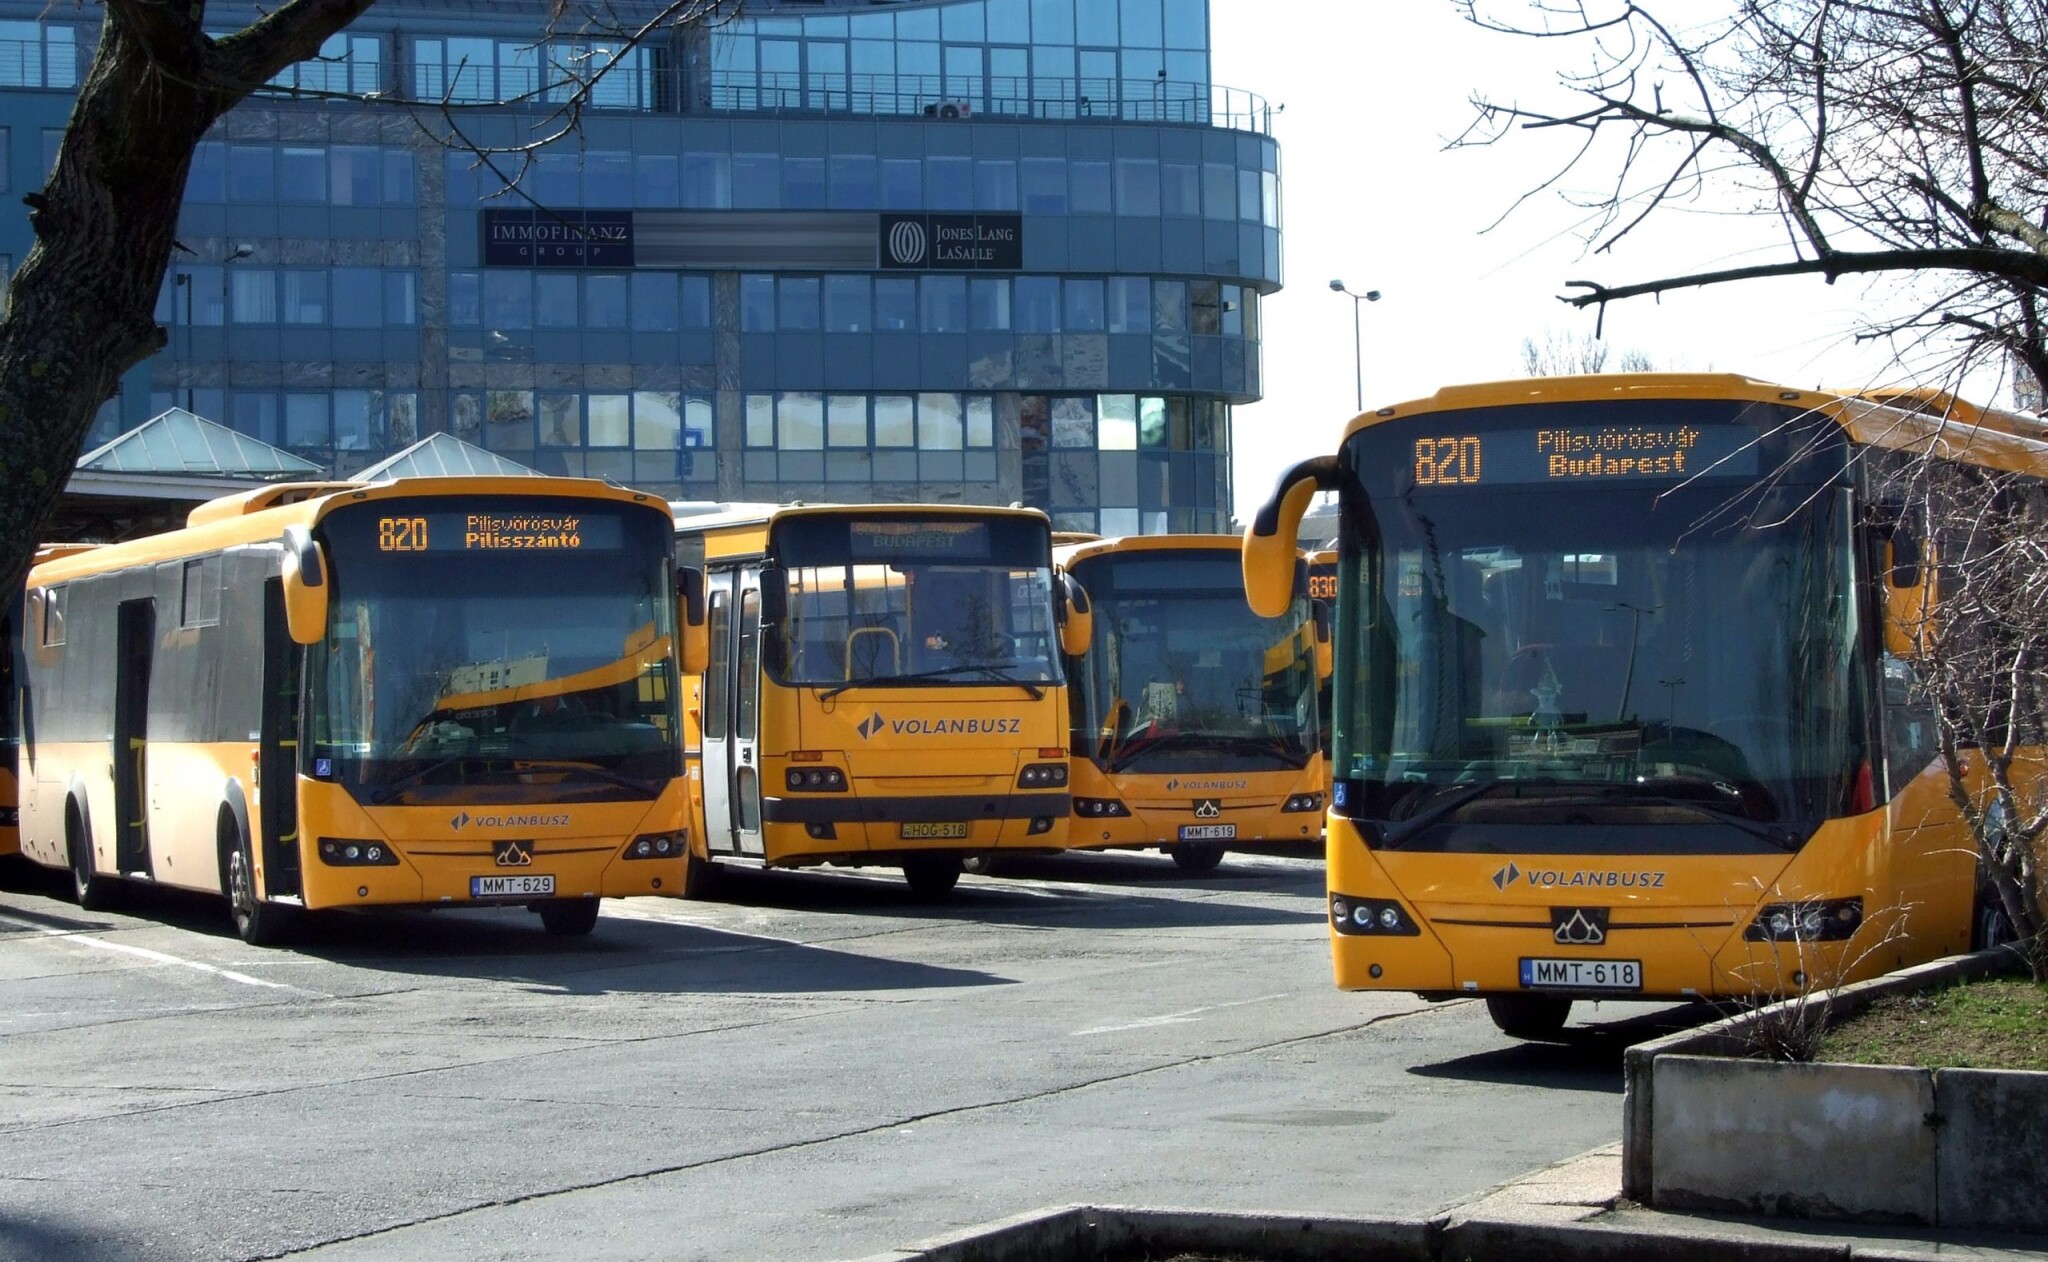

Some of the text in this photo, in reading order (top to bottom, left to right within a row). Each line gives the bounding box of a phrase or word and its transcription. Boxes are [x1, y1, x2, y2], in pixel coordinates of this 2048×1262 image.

[493, 225, 626, 240] IMMOFINANZ
[935, 224, 1013, 243] JONES LANG
[519, 246, 601, 257] GROUP
[1537, 425, 1699, 453] Pilisvörösvár
[1415, 435, 1481, 484] 820
[1550, 450, 1686, 477] Budapest
[466, 515, 580, 531] Pilisvörösvár
[379, 518, 428, 550] 820
[466, 531, 580, 548] Pilisszántó
[873, 535, 954, 548] BUDAPEST
[1310, 575, 1338, 598] 830
[912, 824, 965, 836] HOG-518
[1187, 826, 1233, 838] MMT-619
[483, 877, 550, 893] MMT-629
[1537, 962, 1635, 984] MMT-618
